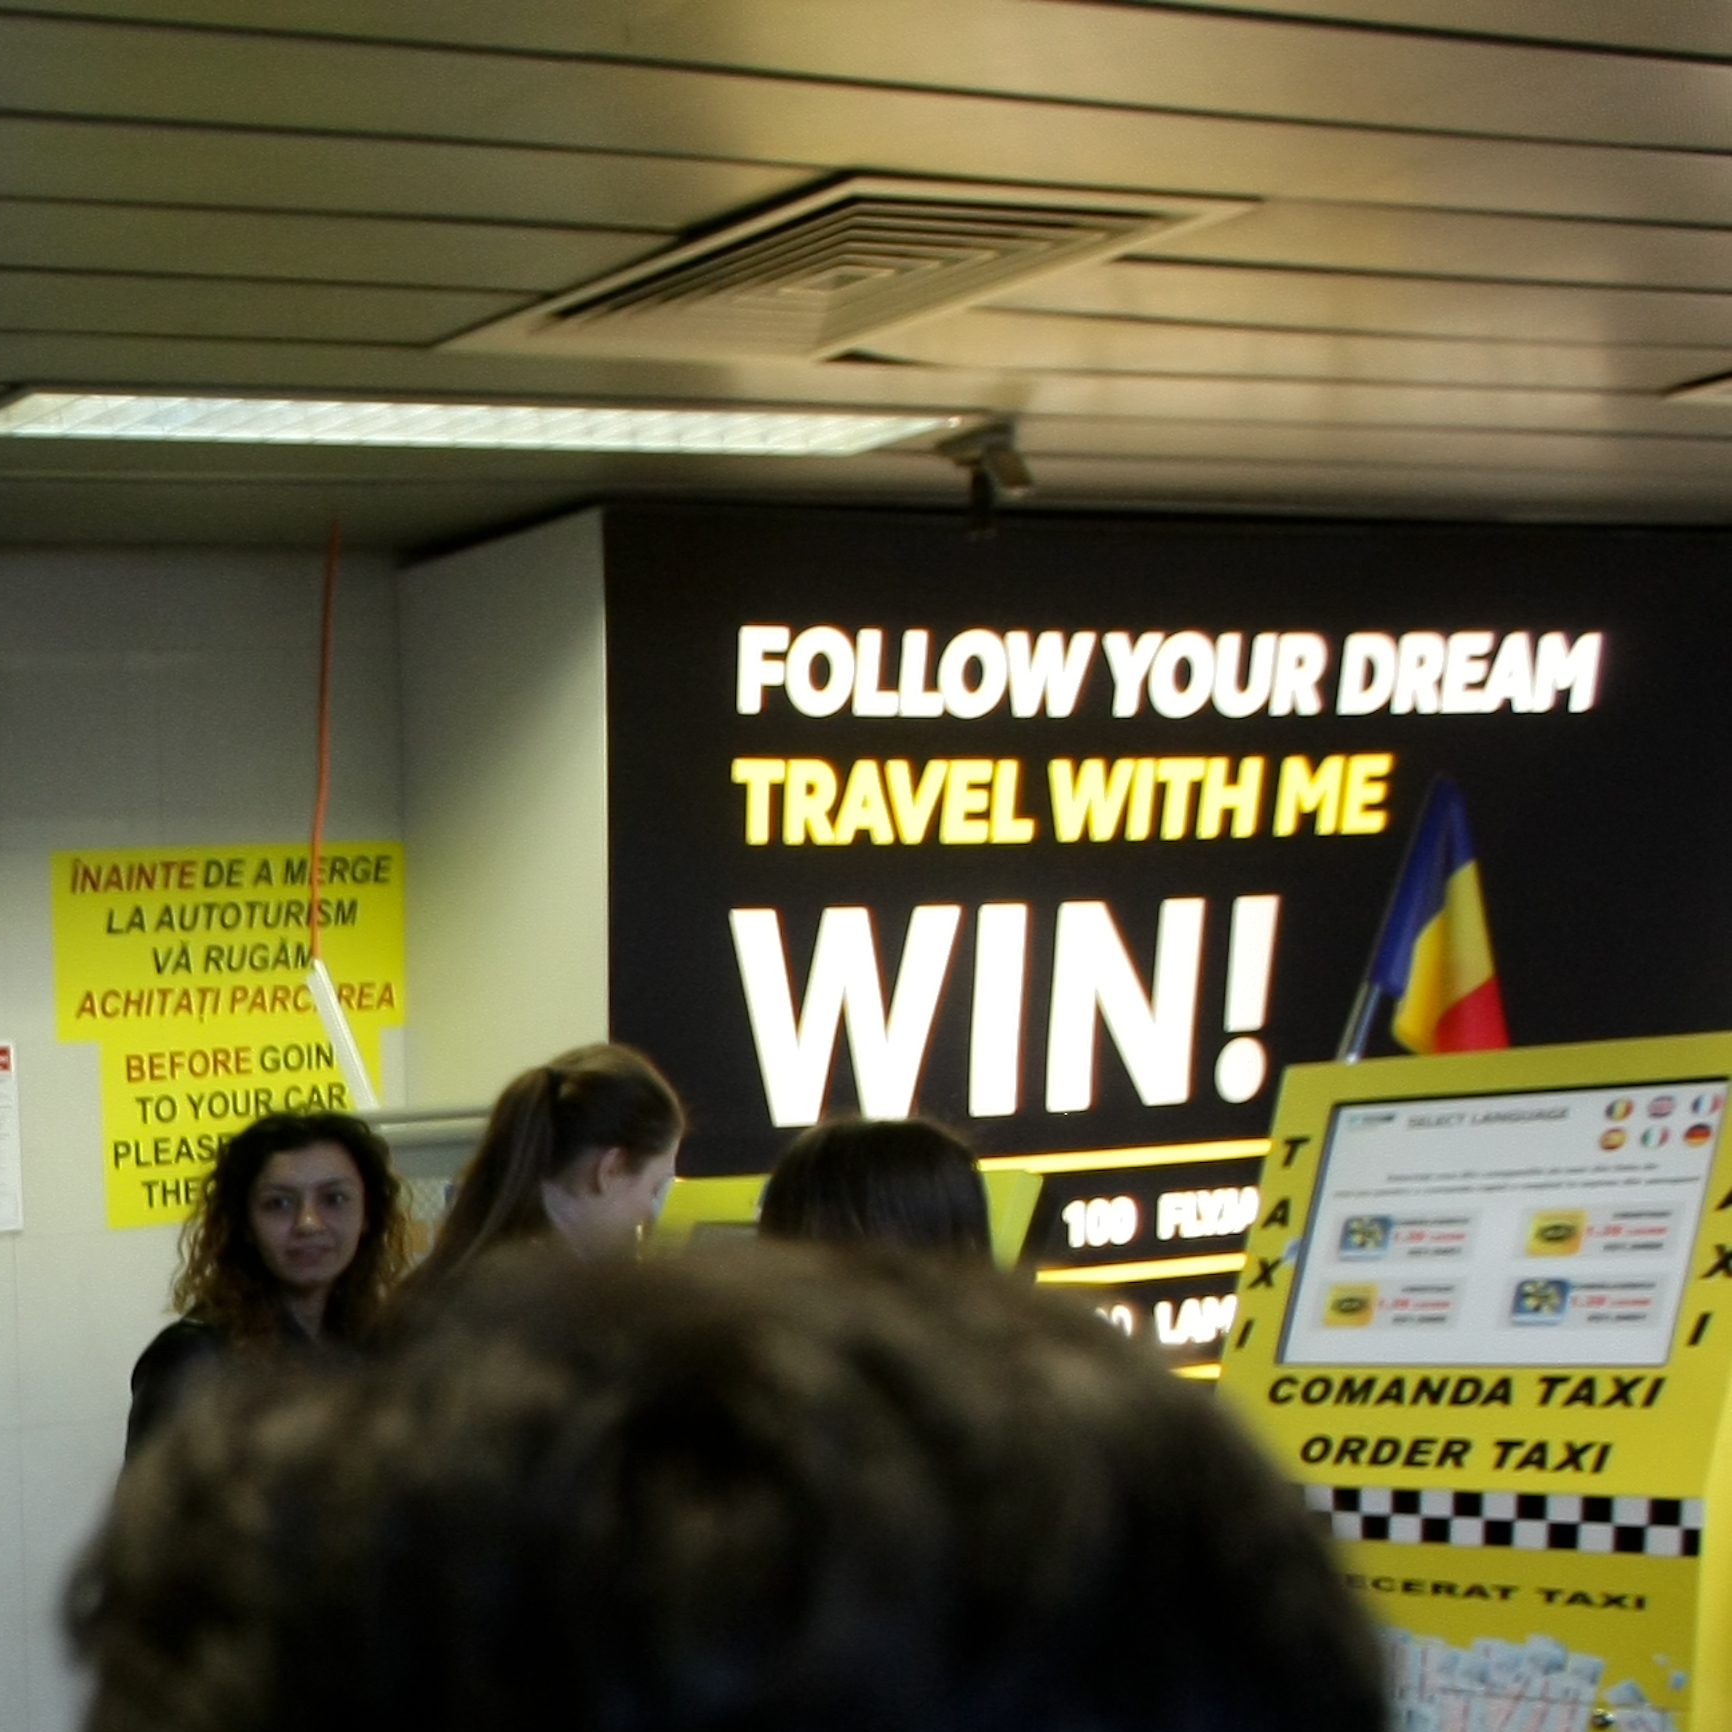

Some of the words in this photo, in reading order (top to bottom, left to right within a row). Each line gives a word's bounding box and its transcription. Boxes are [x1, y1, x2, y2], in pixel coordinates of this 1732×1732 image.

[736, 625, 1093, 719] FOLLOW
[1104, 631, 1325, 719] YOUR
[1337, 631, 1605, 717] DREAM
[731, 757, 1035, 846] TRAVEL
[1049, 753, 1265, 844] WITH
[1274, 752, 1394, 838] ME
[71, 857, 198, 893] ÎNAINTE
[204, 857, 244, 889] DE
[254, 858, 274, 887] A
[283, 854, 392, 886] MERGE
[106, 904, 147, 935] LA
[229, 981, 397, 1015] PARCREA
[729, 894, 1281, 1128] WIN!
[125, 1046, 253, 1083] BEFORE
[260, 1042, 335, 1073] GOIN
[136, 1095, 178, 1124] TO
[185, 1086, 273, 1120] YOUR
[284, 1082, 348, 1112] CAR
[1062, 1196, 1138, 1248] 100
[1268, 1375, 1514, 1407] COMANDA
[1536, 1376, 1666, 1409] TAXI
[1299, 1435, 1472, 1469] ORDER
[1491, 1439, 1612, 1474] TAXI
[1537, 1587, 1647, 1611] TAXI
